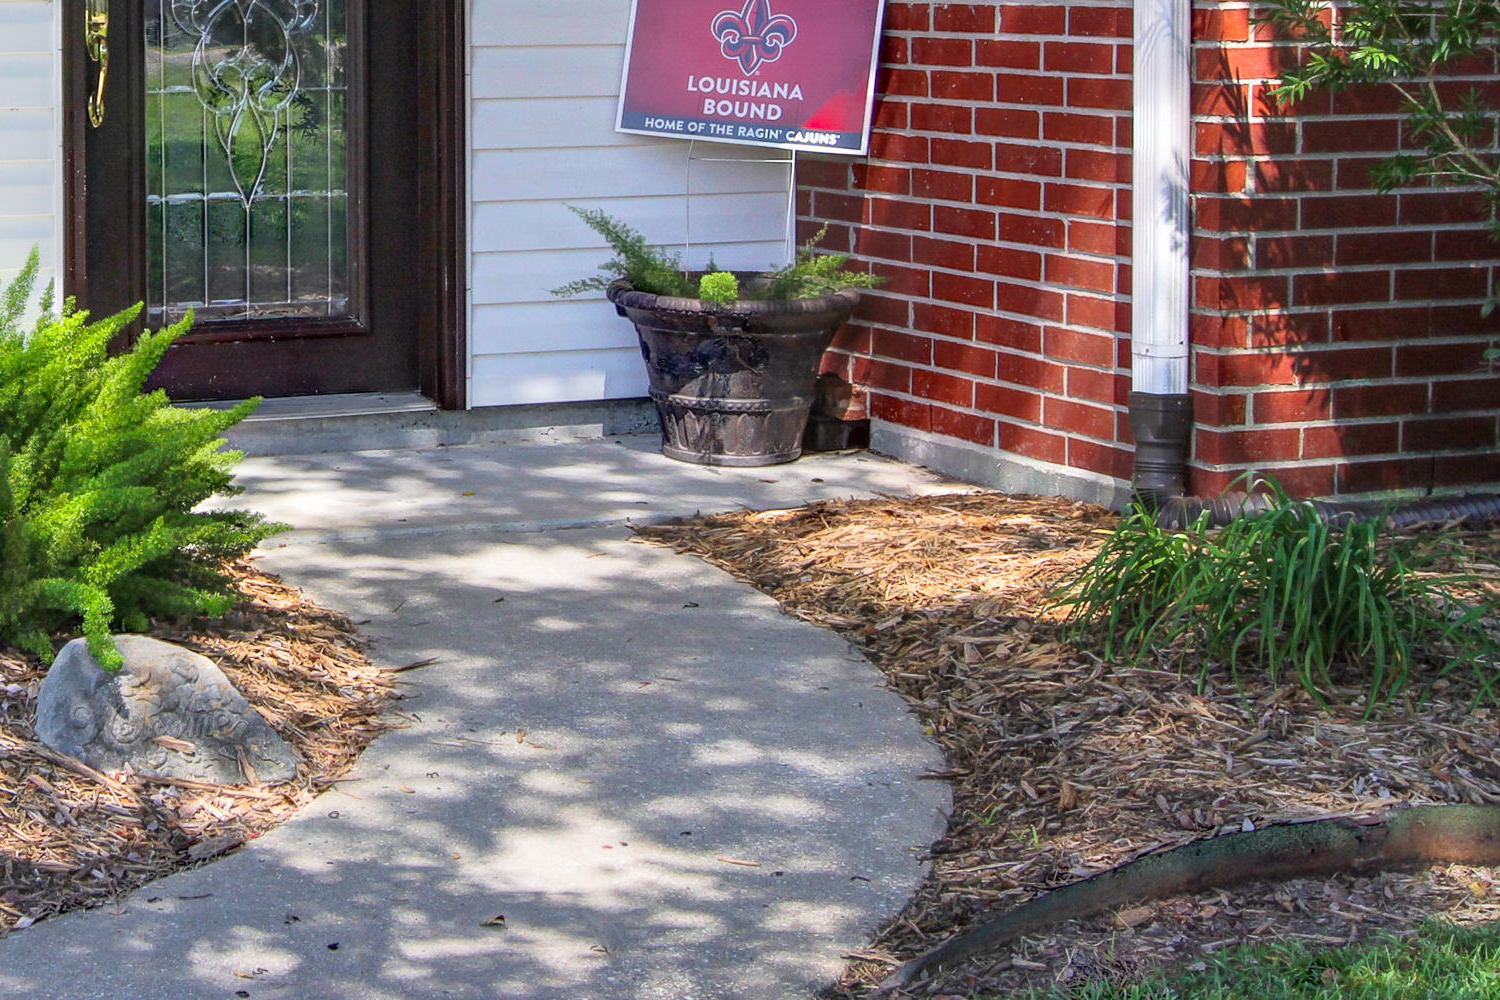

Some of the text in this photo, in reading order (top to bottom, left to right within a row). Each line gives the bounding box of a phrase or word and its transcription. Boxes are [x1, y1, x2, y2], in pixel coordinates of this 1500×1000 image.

[687, 75, 804, 101] LOUISIANA
[703, 98, 782, 121] BOUND
[644, 117, 684, 131] HOME
[687, 121, 706, 133] OF
[709, 123, 733, 136] THE
[737, 126, 783, 140] RAGIN'
